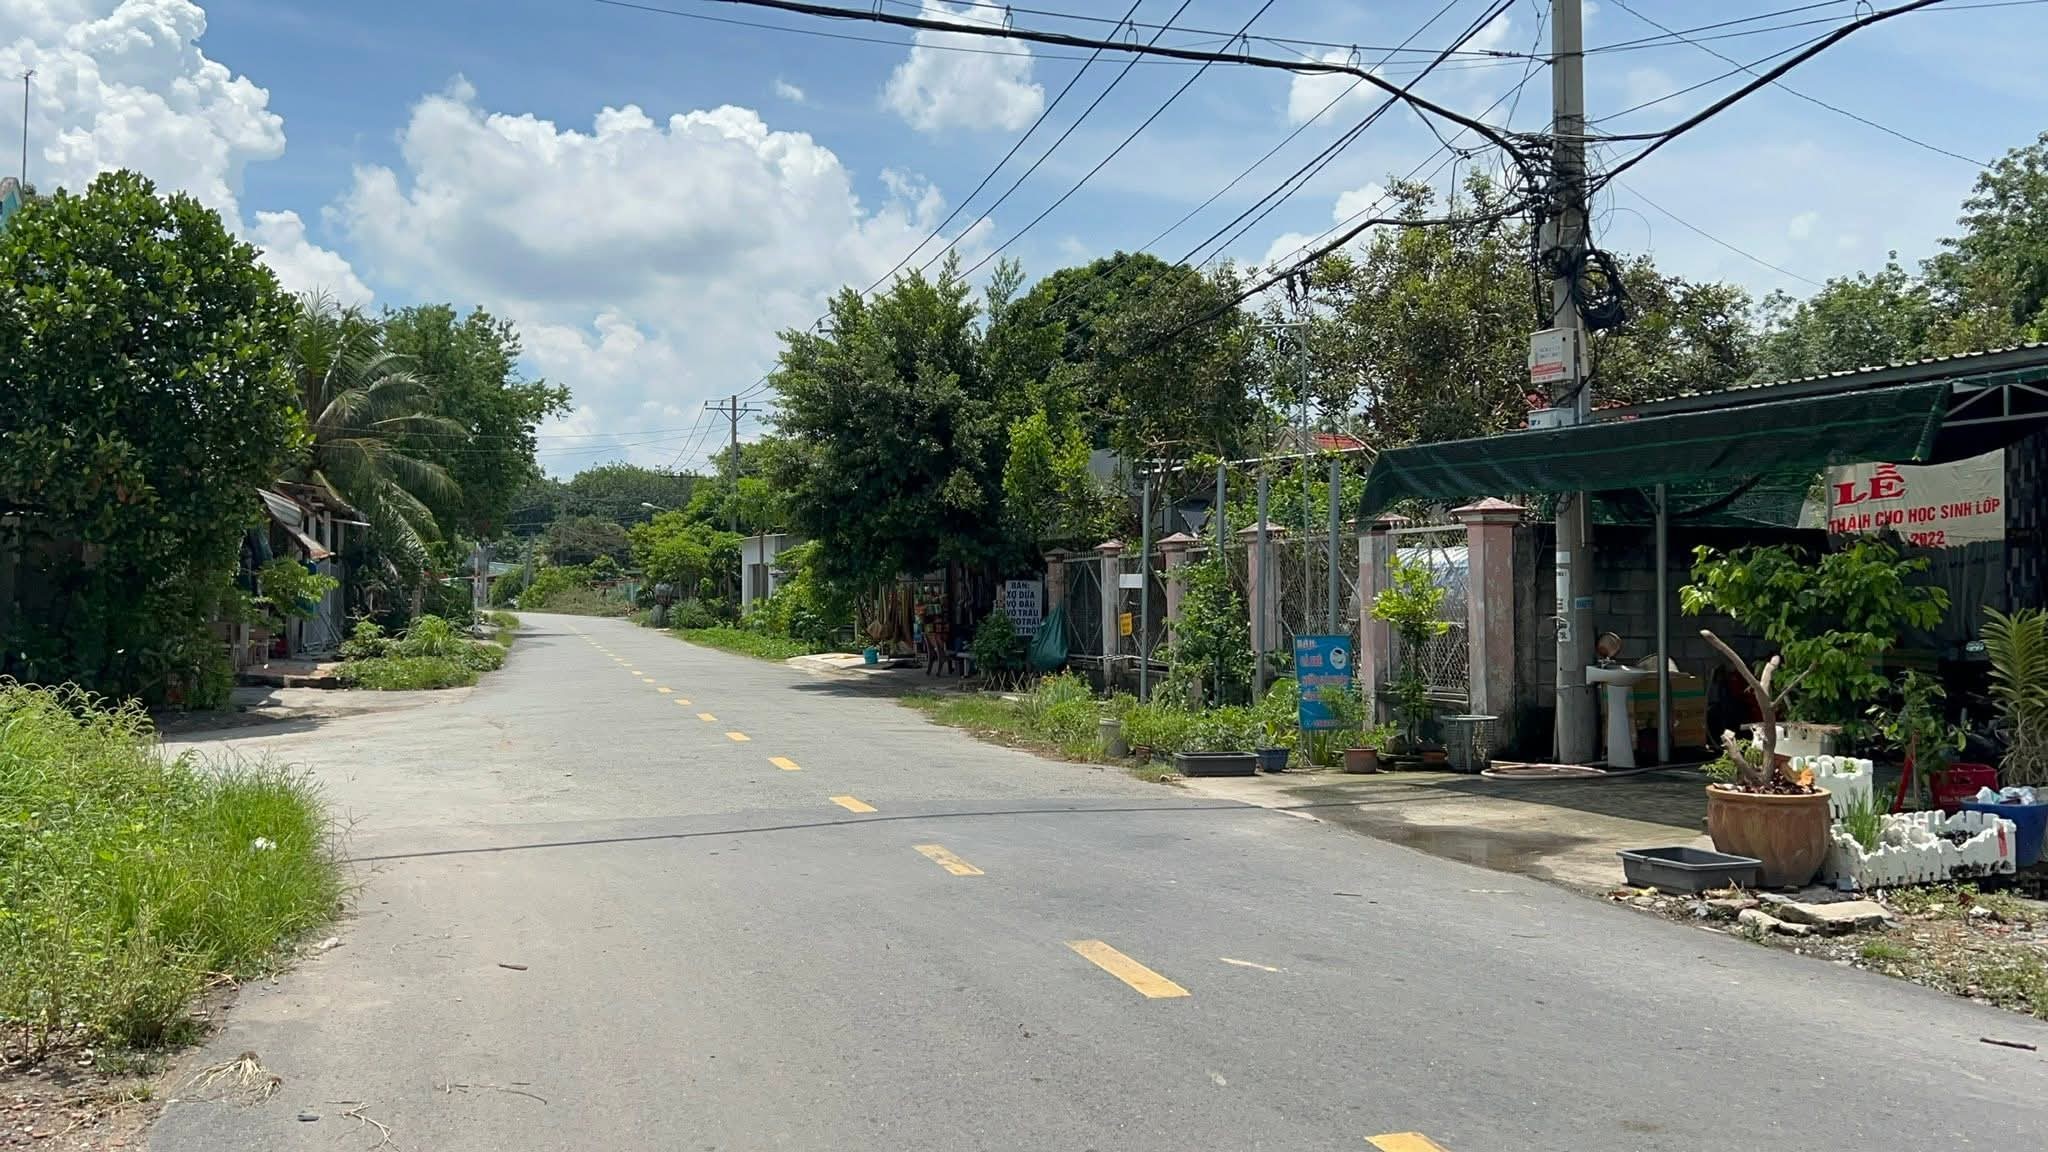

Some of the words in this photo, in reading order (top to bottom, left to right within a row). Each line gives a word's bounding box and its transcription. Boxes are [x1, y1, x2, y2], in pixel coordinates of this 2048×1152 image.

[1908, 506, 1936, 526] HỌC
[1940, 502, 1972, 519] SINH
[1911, 530, 1945, 547] 2022
